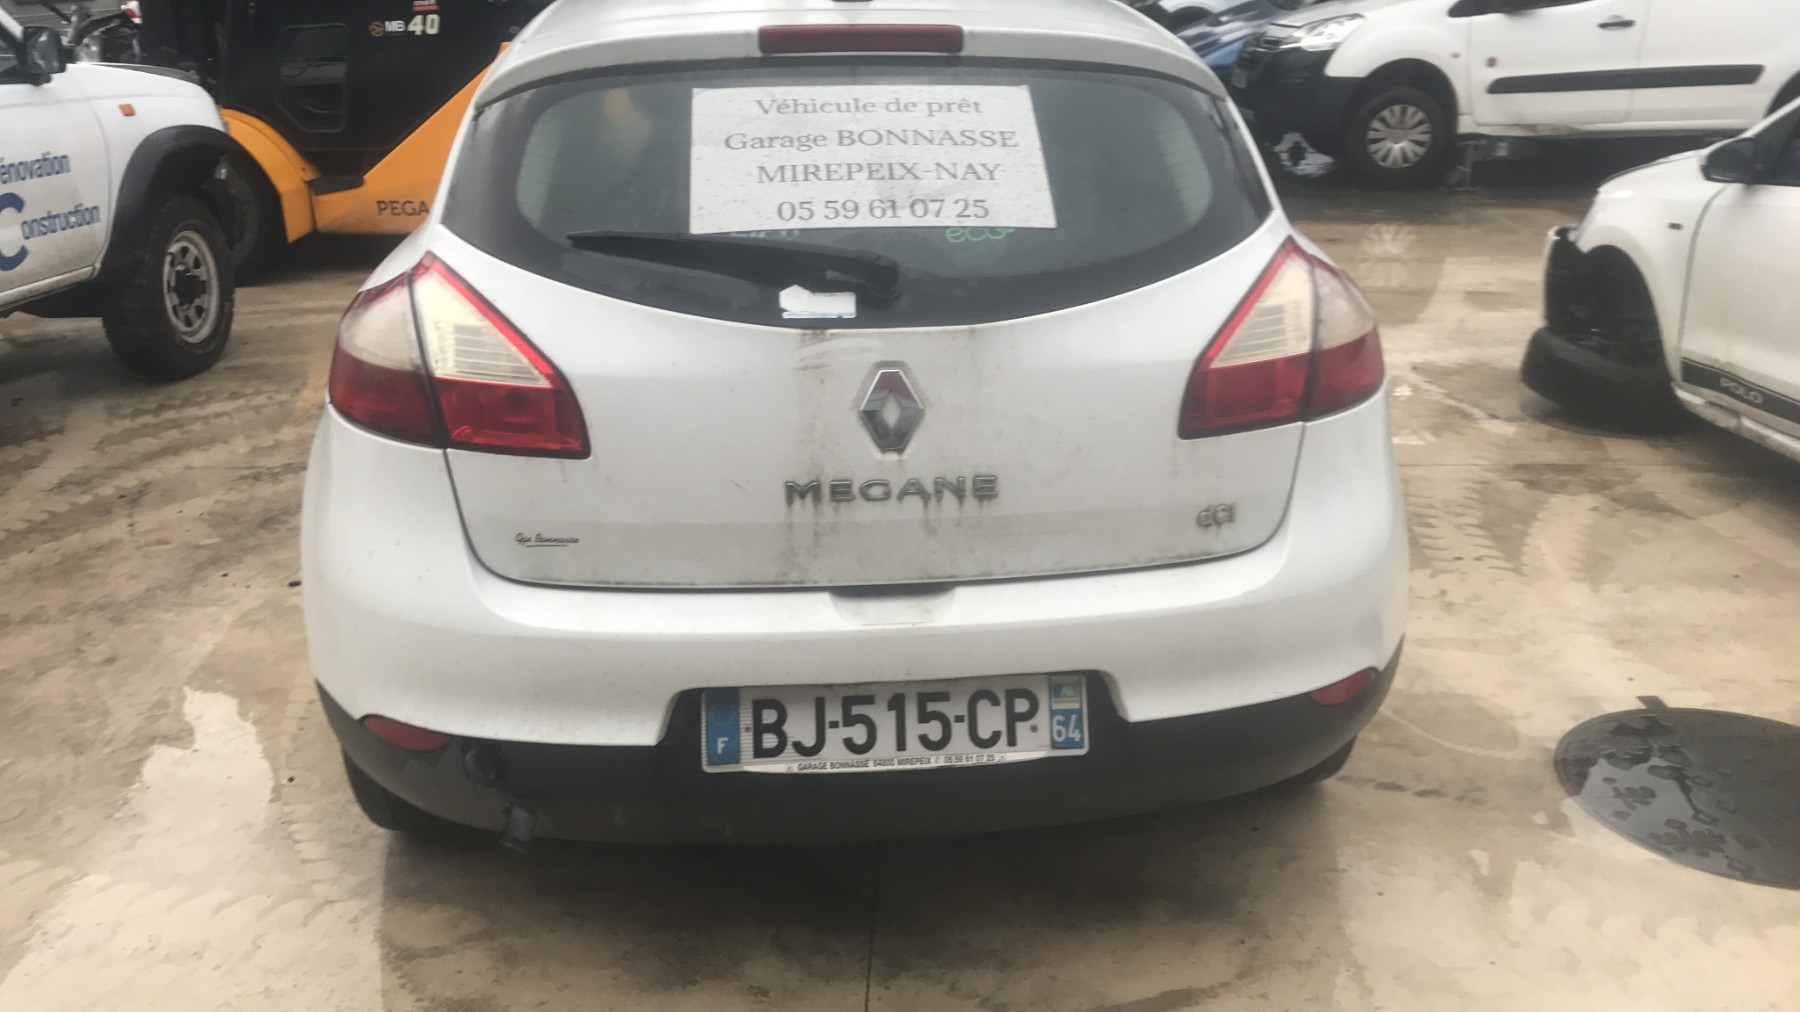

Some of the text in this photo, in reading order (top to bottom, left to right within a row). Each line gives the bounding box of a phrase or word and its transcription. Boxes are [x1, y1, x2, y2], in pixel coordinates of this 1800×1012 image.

[385, 14, 440, 35] MB 40
[756, 98, 983, 116] Véhicule de prêt
[724, 130, 1018, 151] Garage BONNASSE
[756, 163, 1001, 183] MIREPEIX-NAY
[777, 199, 989, 221] 05 59 61 07 25
[1719, 377, 1764, 404] POLO
[784, 475, 999, 504] MEGANE
[717, 688, 1081, 759] F BJ-515-CP 64
[797, 762, 828, 770] GARAGE
[897, 757, 932, 766] MIREPEIX
